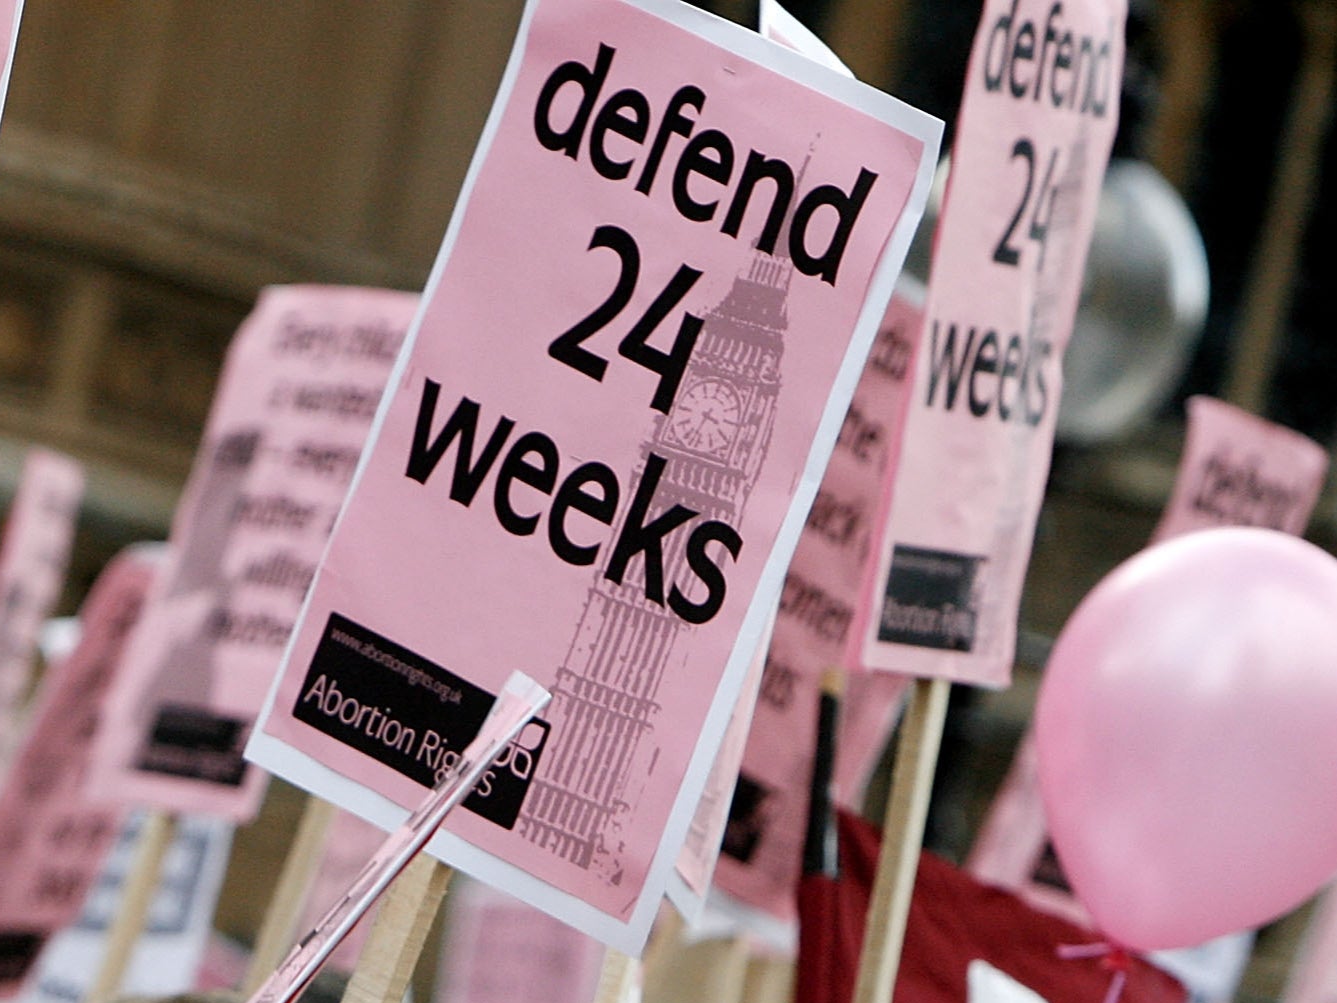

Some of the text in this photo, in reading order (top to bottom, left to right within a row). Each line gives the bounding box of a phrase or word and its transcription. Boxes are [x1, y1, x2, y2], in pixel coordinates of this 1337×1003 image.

[534, 41, 878, 287] defend
[547, 225, 705, 417] 24
[404, 377, 744, 626] weeks
[303, 673, 497, 798] Abortion Rigs
